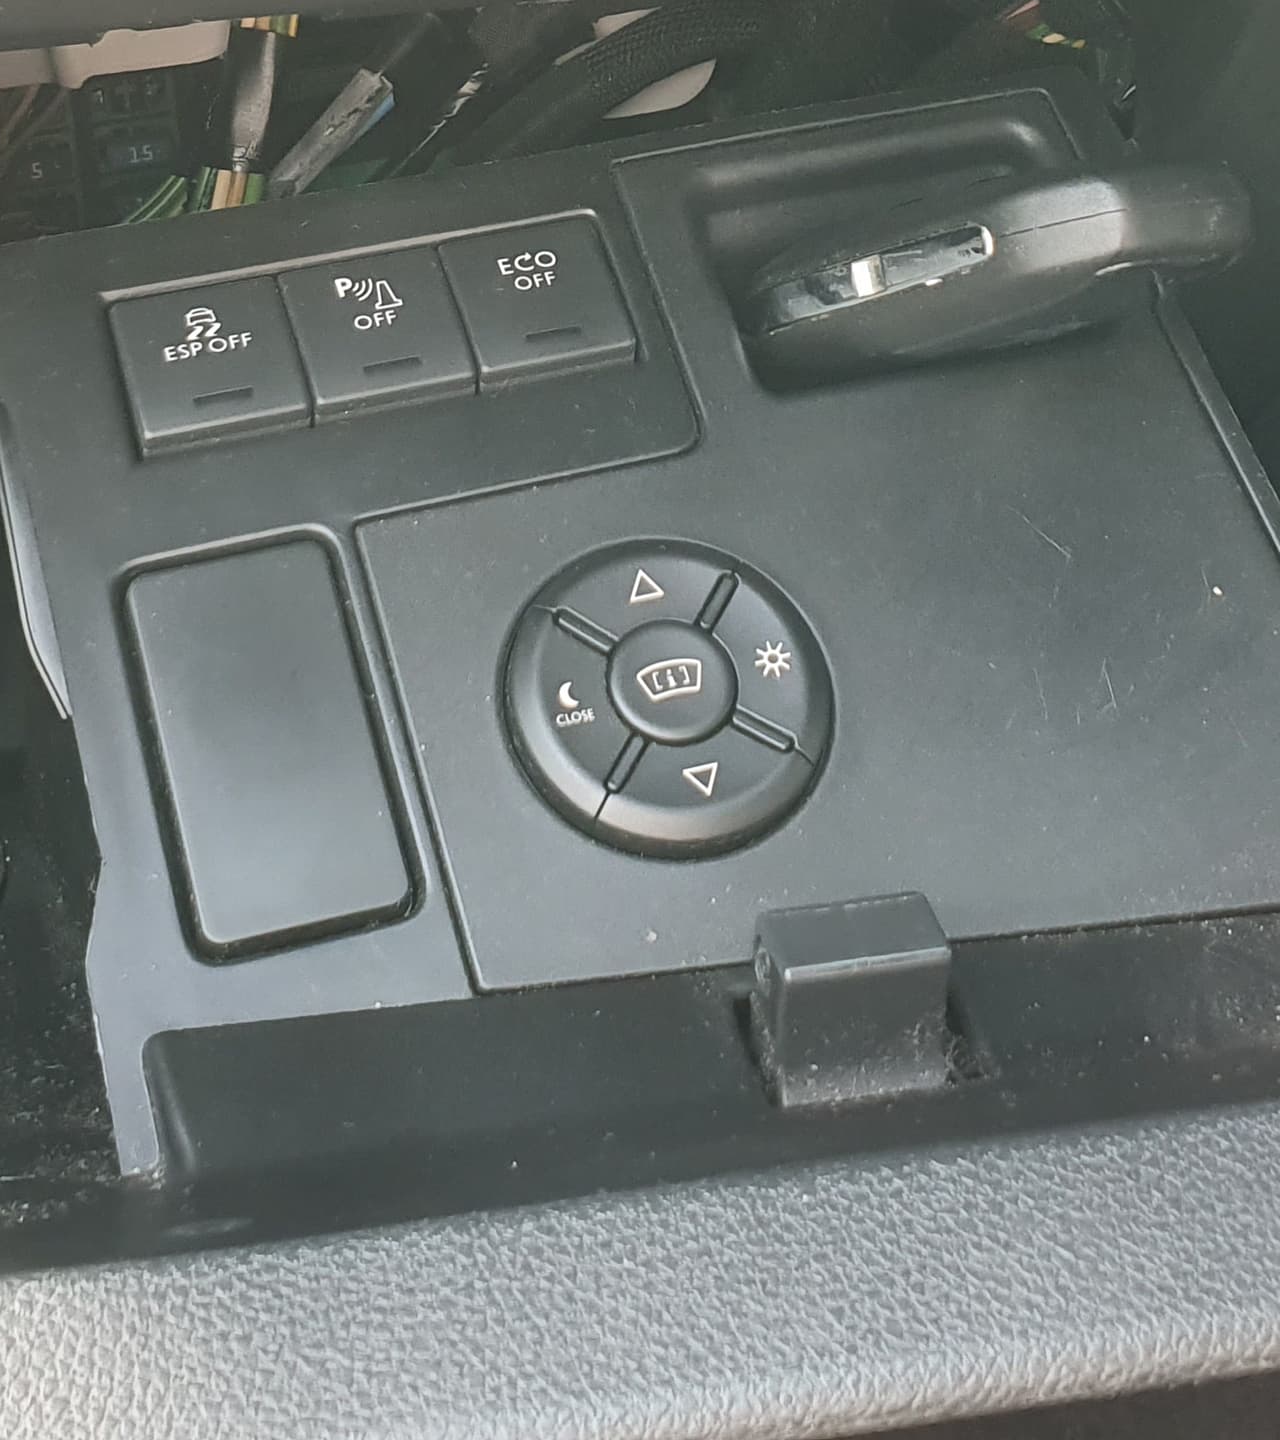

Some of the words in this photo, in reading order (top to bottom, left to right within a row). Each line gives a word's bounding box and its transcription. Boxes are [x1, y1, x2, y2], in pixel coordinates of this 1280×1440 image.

[497, 251, 557, 275] ECO
[334, 277, 353, 298] P
[514, 271, 556, 290] OFF
[353, 309, 397, 330] OFF
[163, 341, 203, 362] ESP
[207, 331, 253, 353] OFF
[556, 707, 596, 728] CLOSE
